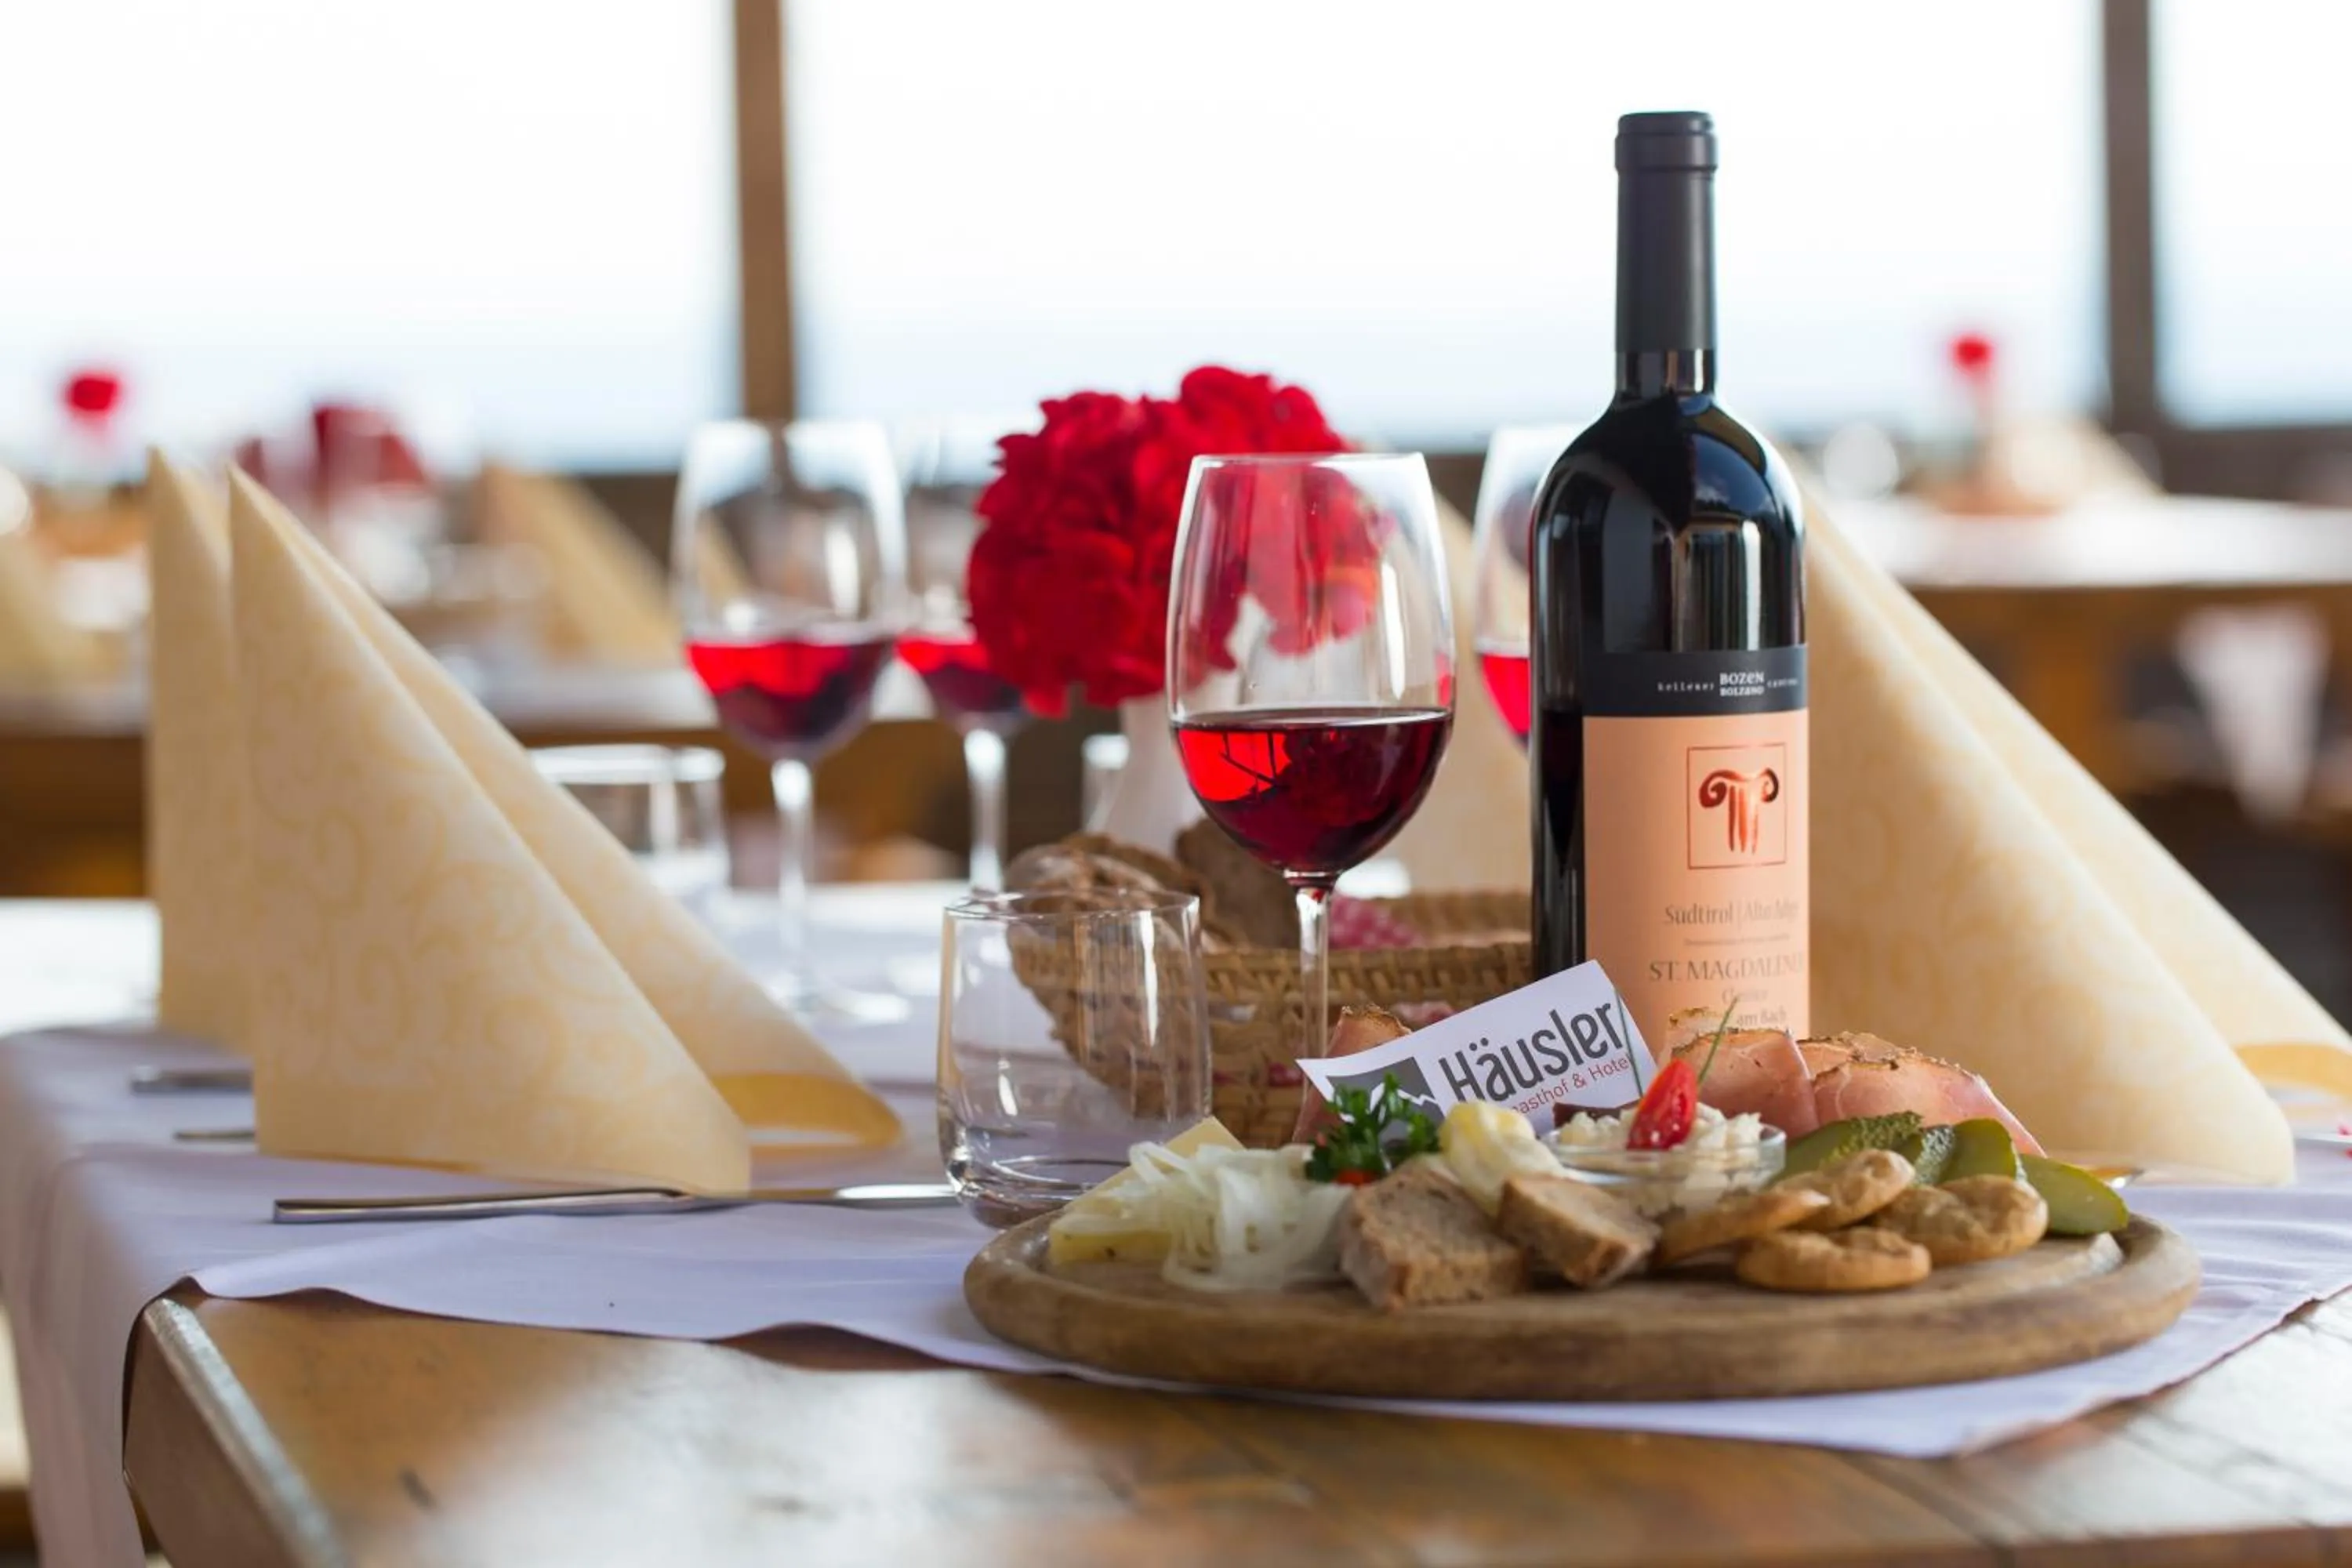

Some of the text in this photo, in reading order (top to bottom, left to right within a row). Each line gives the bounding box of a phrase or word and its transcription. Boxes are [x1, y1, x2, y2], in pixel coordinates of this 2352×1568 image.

[1438, 1003, 1624, 1103] Häusler
[1512, 1078, 1569, 1114] asthof
[1571, 1073, 1588, 1089] &
